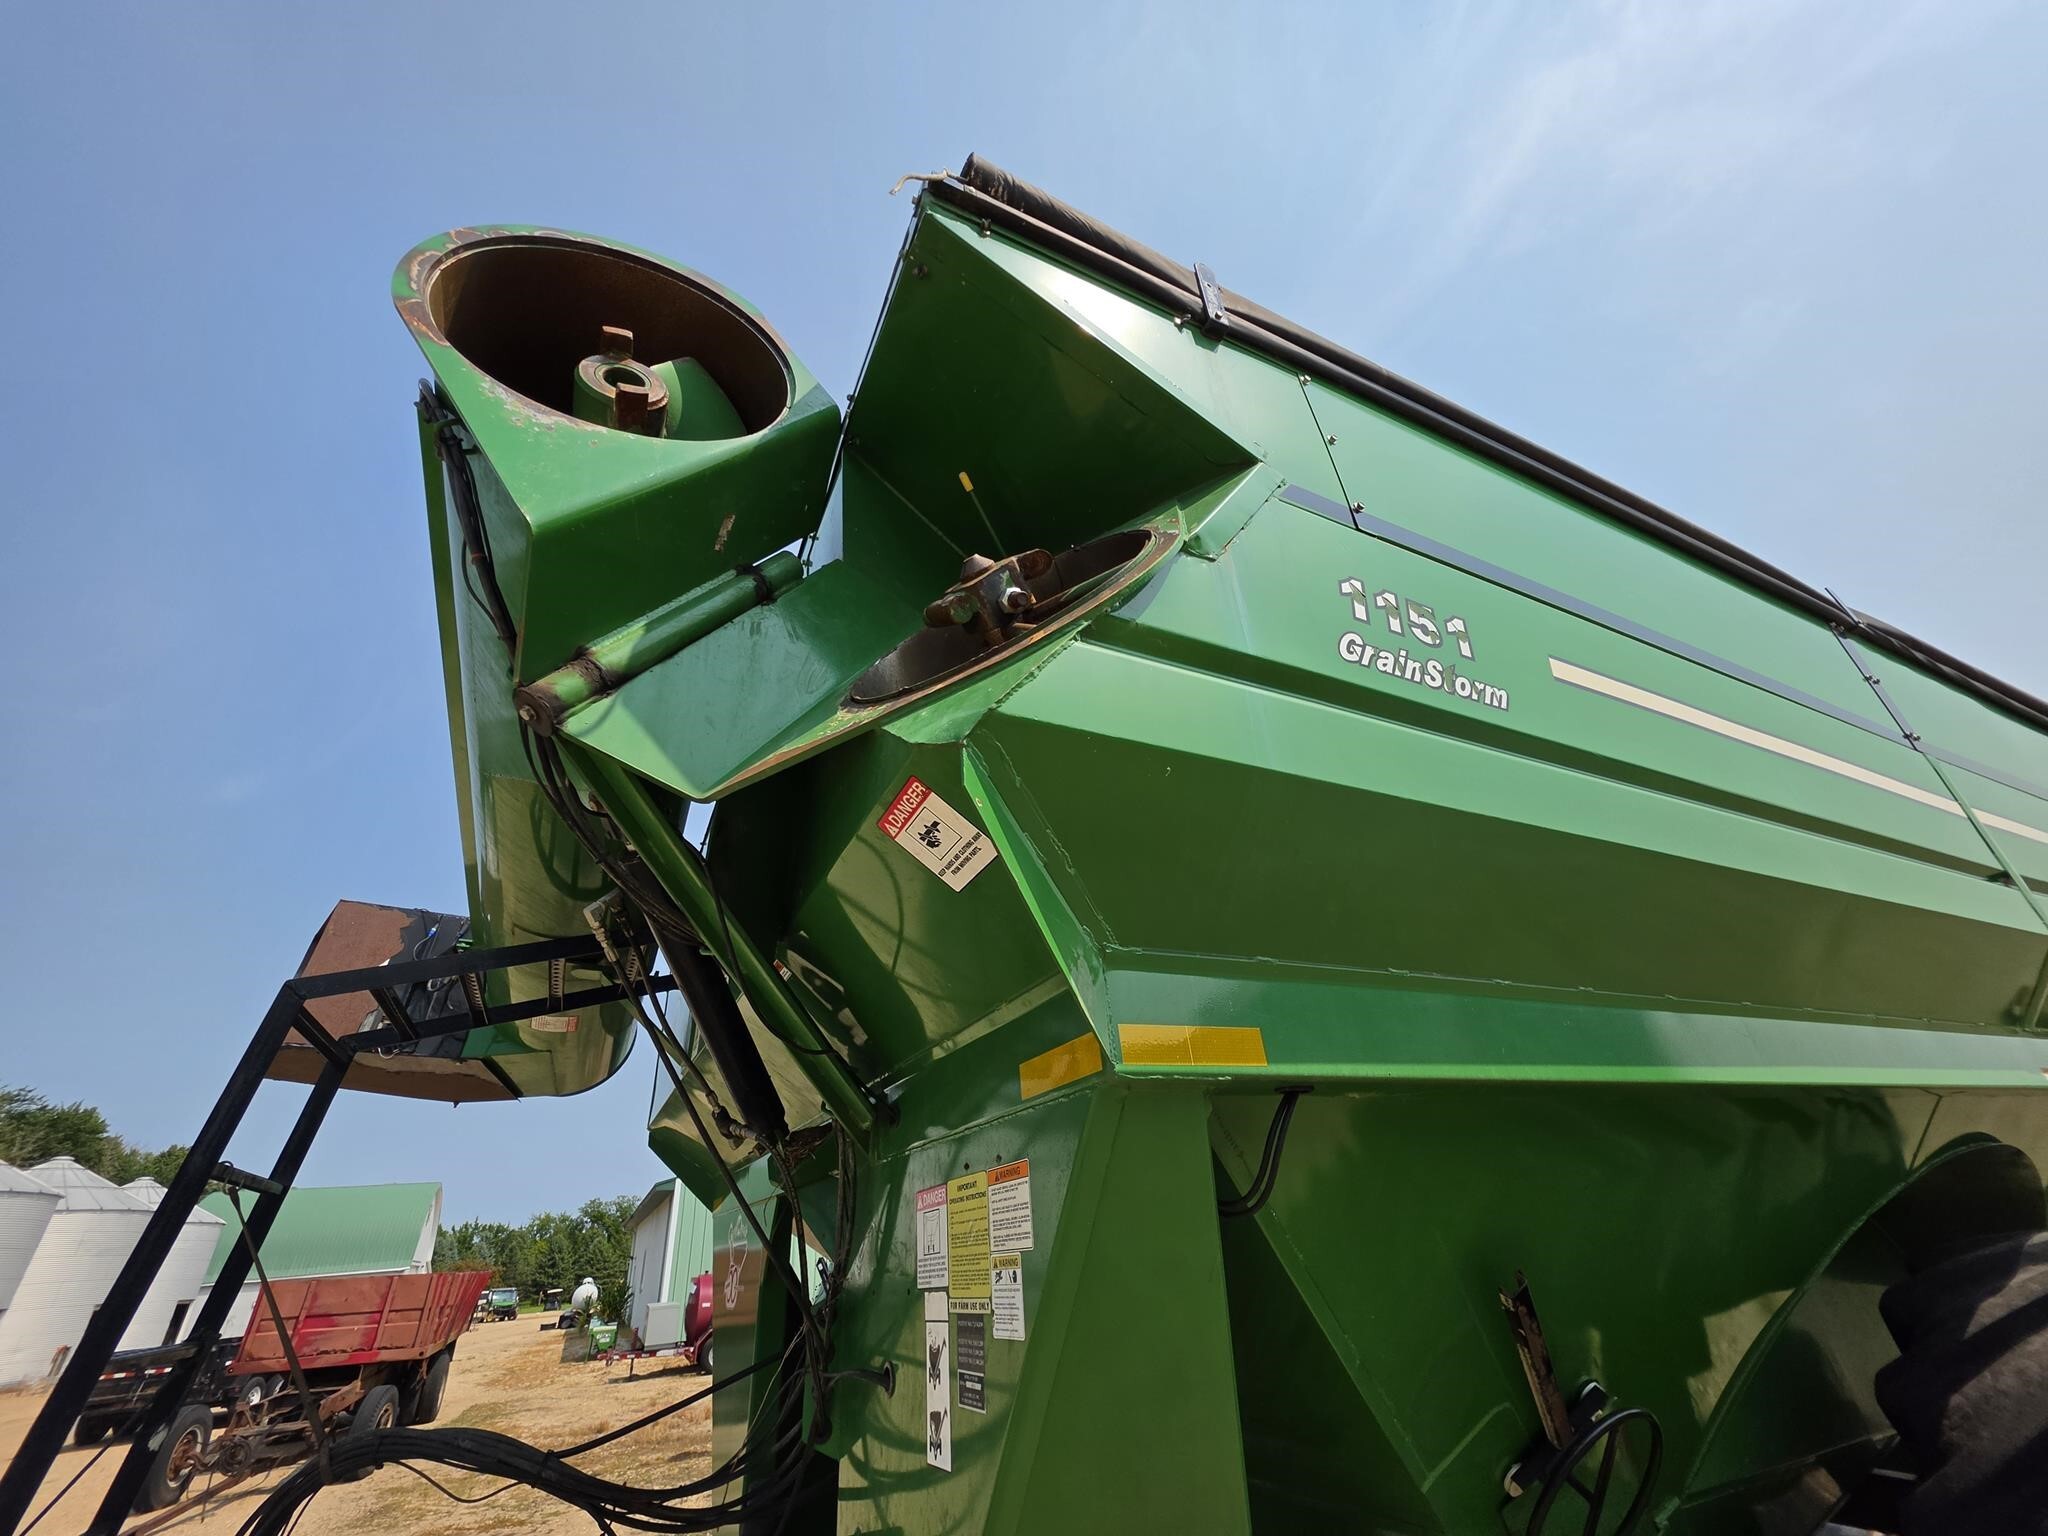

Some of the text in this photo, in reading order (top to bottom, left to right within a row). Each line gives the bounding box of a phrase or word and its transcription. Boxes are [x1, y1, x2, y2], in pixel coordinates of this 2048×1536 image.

[1339, 577, 1474, 660] 1151
[1339, 632, 1509, 710] GrainStorm
[889, 783, 926, 828] DANGER
[944, 859, 956, 870] HANDS
[953, 853, 961, 862] AND
[951, 866, 961, 875] FROM
[958, 855, 972, 868] MOVING
[999, 1166, 1020, 1179] WARNING
[957, 1181, 977, 1192] IMPORTANT
[923, 1188, 945, 1206] DANGER
[999, 1258, 1019, 1268] WARNING
[958, 1302, 969, 1311] FARM
[969, 1301, 978, 1310] USE
[978, 1301, 990, 1311] ONLY
